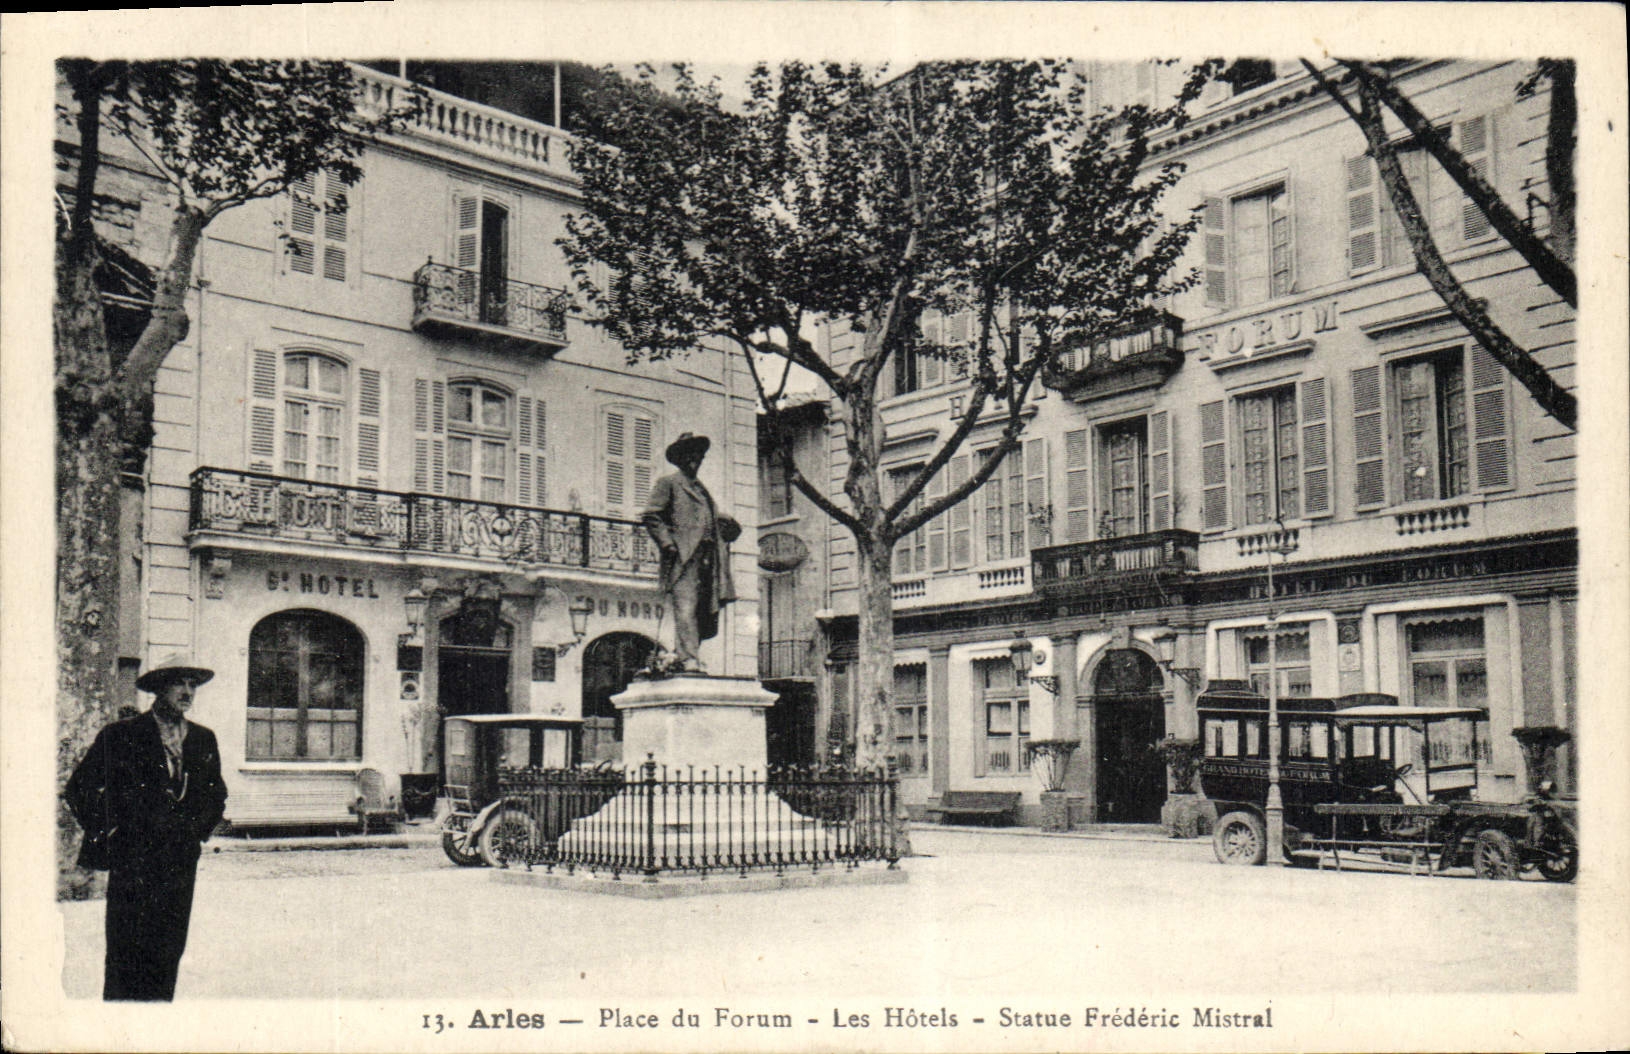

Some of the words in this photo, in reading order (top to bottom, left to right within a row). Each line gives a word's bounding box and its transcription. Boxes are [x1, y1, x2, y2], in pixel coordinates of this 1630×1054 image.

[1199, 301, 1339, 362] FORUM
[300, 572, 380, 599] HOTEL
[617, 600, 665, 621] NORD
[1202, 763, 1238, 775] GRAND
